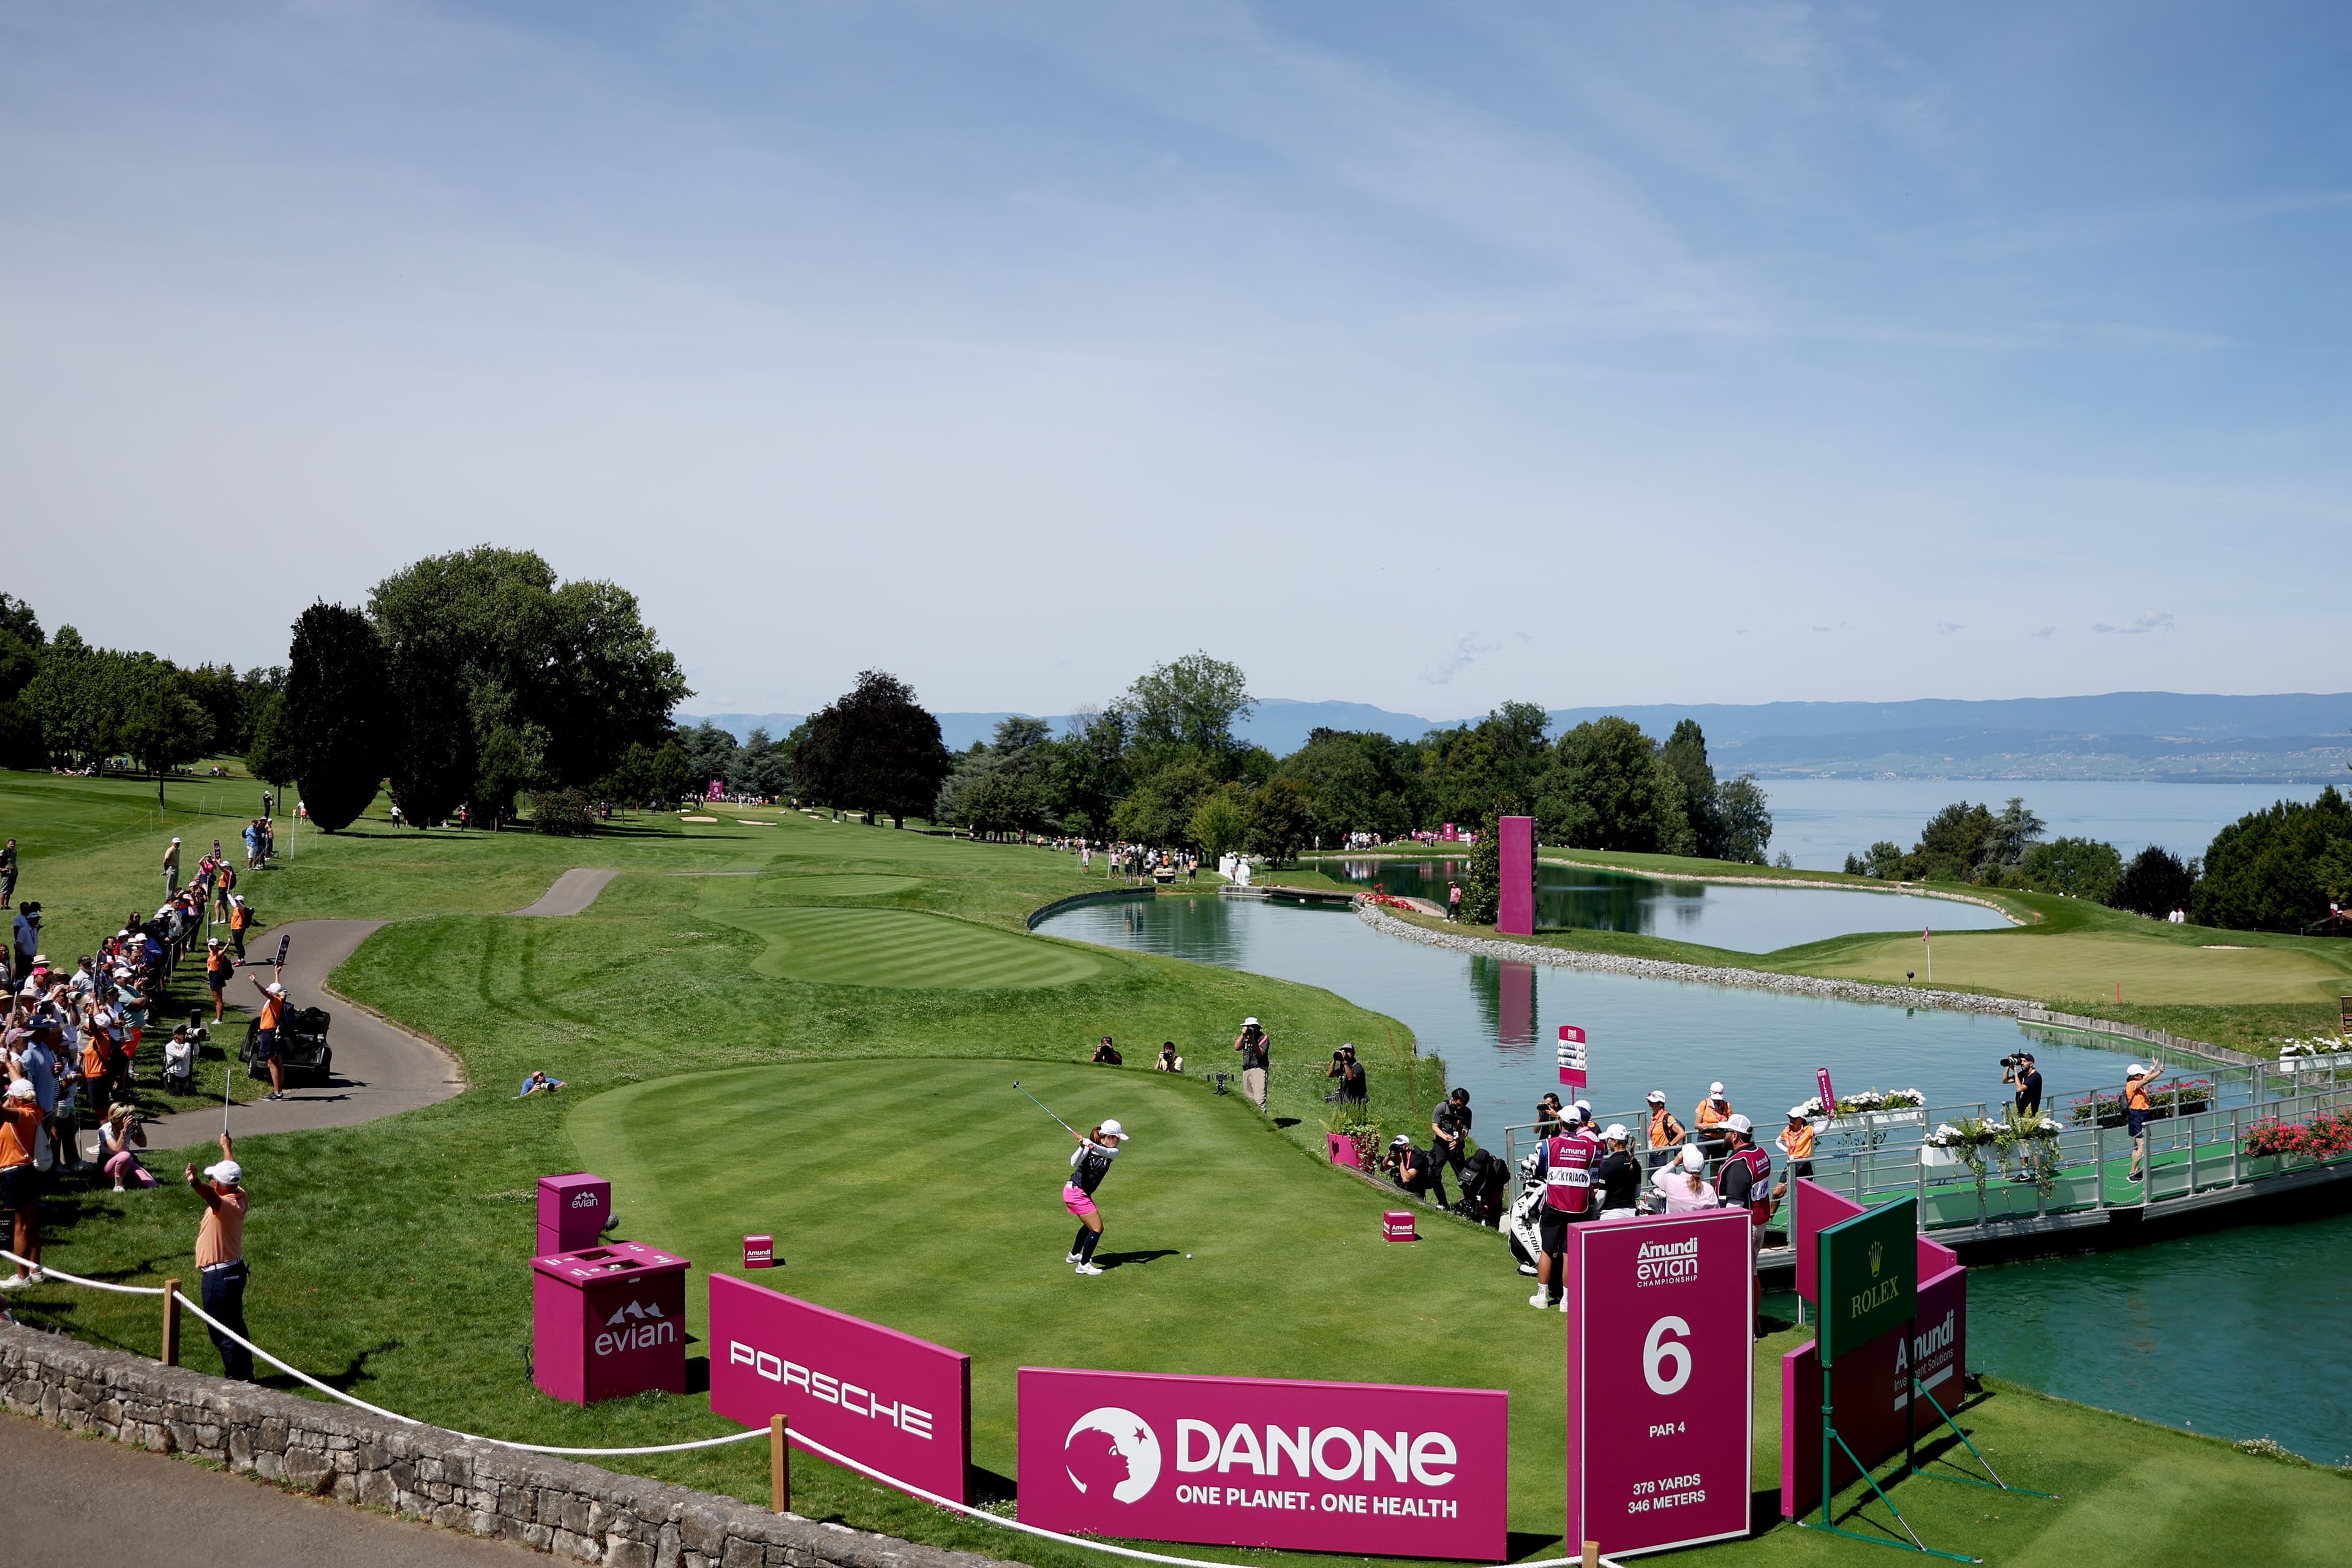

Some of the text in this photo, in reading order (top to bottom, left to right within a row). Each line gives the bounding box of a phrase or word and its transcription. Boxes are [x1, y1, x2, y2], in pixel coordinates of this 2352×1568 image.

[1821, 1077, 1830, 1106] SILENCE
[571, 1197, 598, 1208] evian
[1515, 1216, 1530, 1246] GOLF
[1637, 1237, 1698, 1259] Amundi
[1637, 1259, 1698, 1280] evian
[1637, 1275, 1698, 1288] CHAMPIONSHIP
[1851, 1275, 1899, 1319] ROLEX
[595, 1322, 674, 1356] evian
[1643, 1316, 1692, 1395] 6
[1928, 1348, 1954, 1371] Solutions
[730, 1340, 933, 1441] PORSCHE
[1649, 1421, 1686, 1438] PAR 4
[1633, 1473, 1701, 1495] 378 YARDS
[1176, 1485, 1457, 1519] ONE PLANET. ONE HEALTH
[1628, 1490, 1706, 1513] 346 METERS
